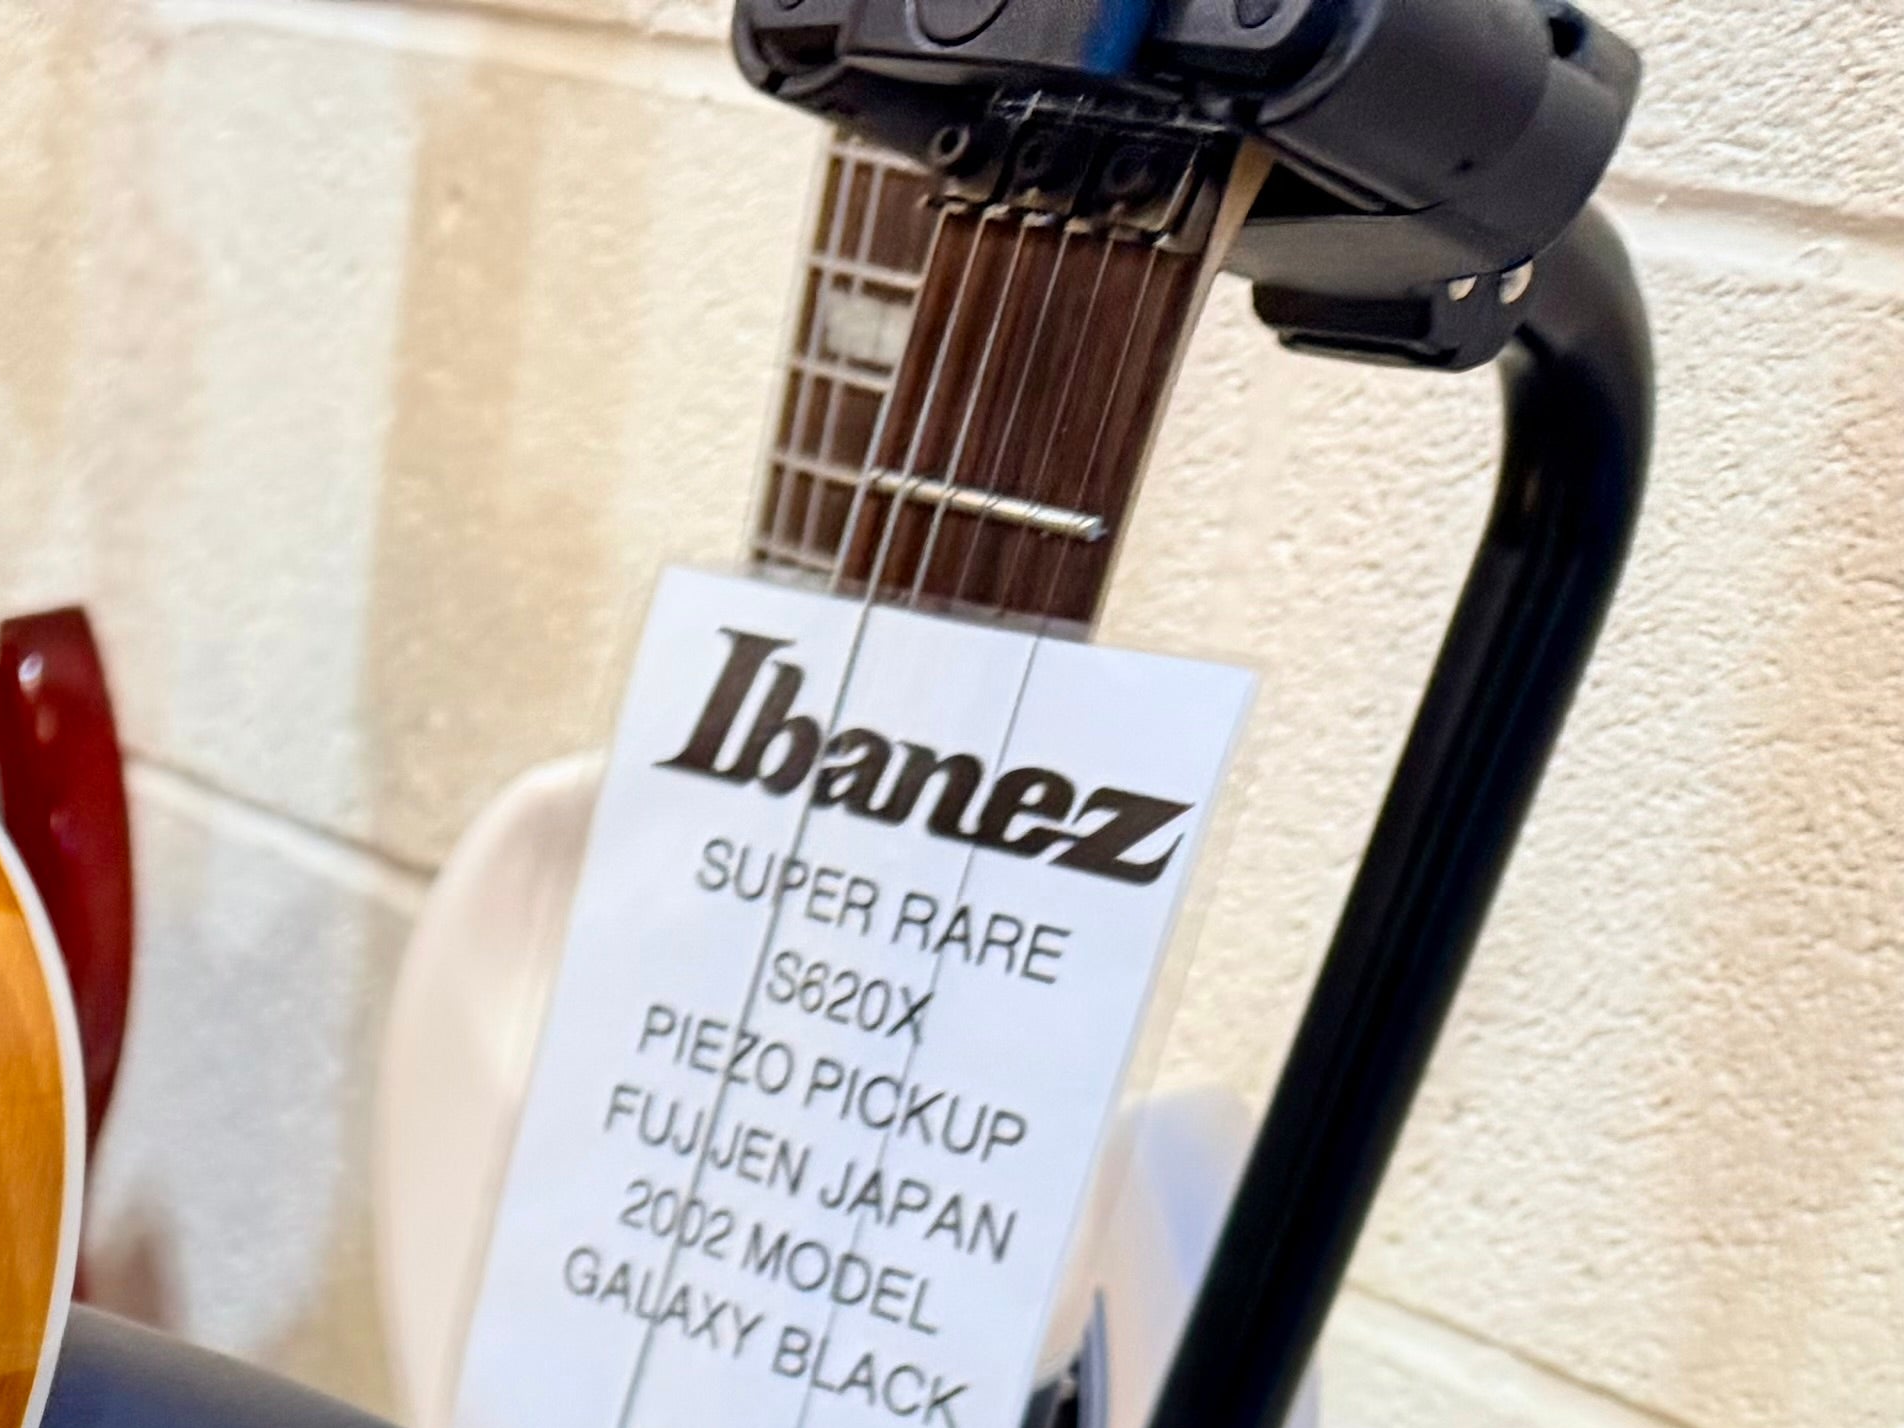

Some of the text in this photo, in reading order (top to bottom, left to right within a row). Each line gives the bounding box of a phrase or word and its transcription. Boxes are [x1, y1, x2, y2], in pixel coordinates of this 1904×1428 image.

[652, 627, 1194, 885] Ibanez
[695, 837, 1073, 984] SUPER RARE
[766, 950, 934, 1045] S620X
[638, 1003, 1028, 1162] PIEZO PICKUP
[604, 1083, 1018, 1264] FUJJEN JAPAN
[562, 1246, 765, 1358] GALAXY
[618, 1179, 939, 1336] 2002 MODEL
